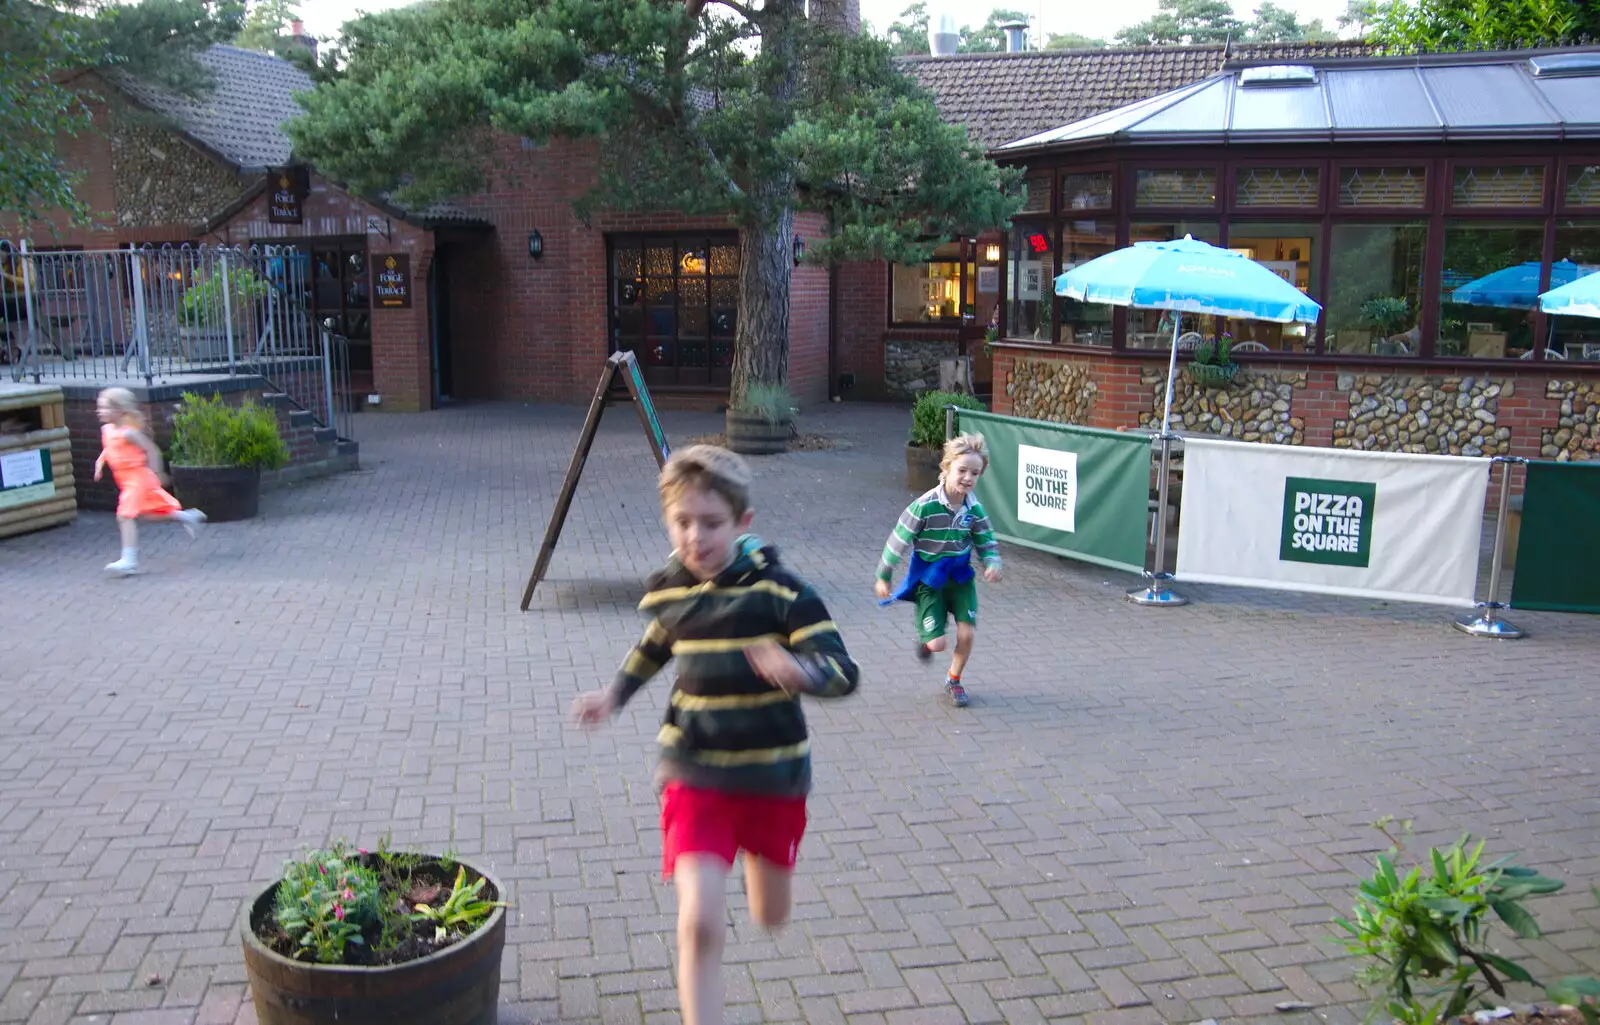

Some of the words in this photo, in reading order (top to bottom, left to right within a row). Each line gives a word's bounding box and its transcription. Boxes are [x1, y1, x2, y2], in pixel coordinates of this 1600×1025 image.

[380, 272, 403, 282] FORGE
[376, 286, 406, 295] TERRACE
[1026, 463, 1068, 480] BREAKFAST
[1026, 475, 1043, 491] ON
[1045, 479, 1068, 496] THE
[1026, 491, 1067, 511] SQUARE
[1294, 491, 1363, 517] PIZZA
[1293, 513, 1323, 533] ON
[1325, 516, 1361, 536] THE
[1291, 532, 1359, 553] SQUARE
